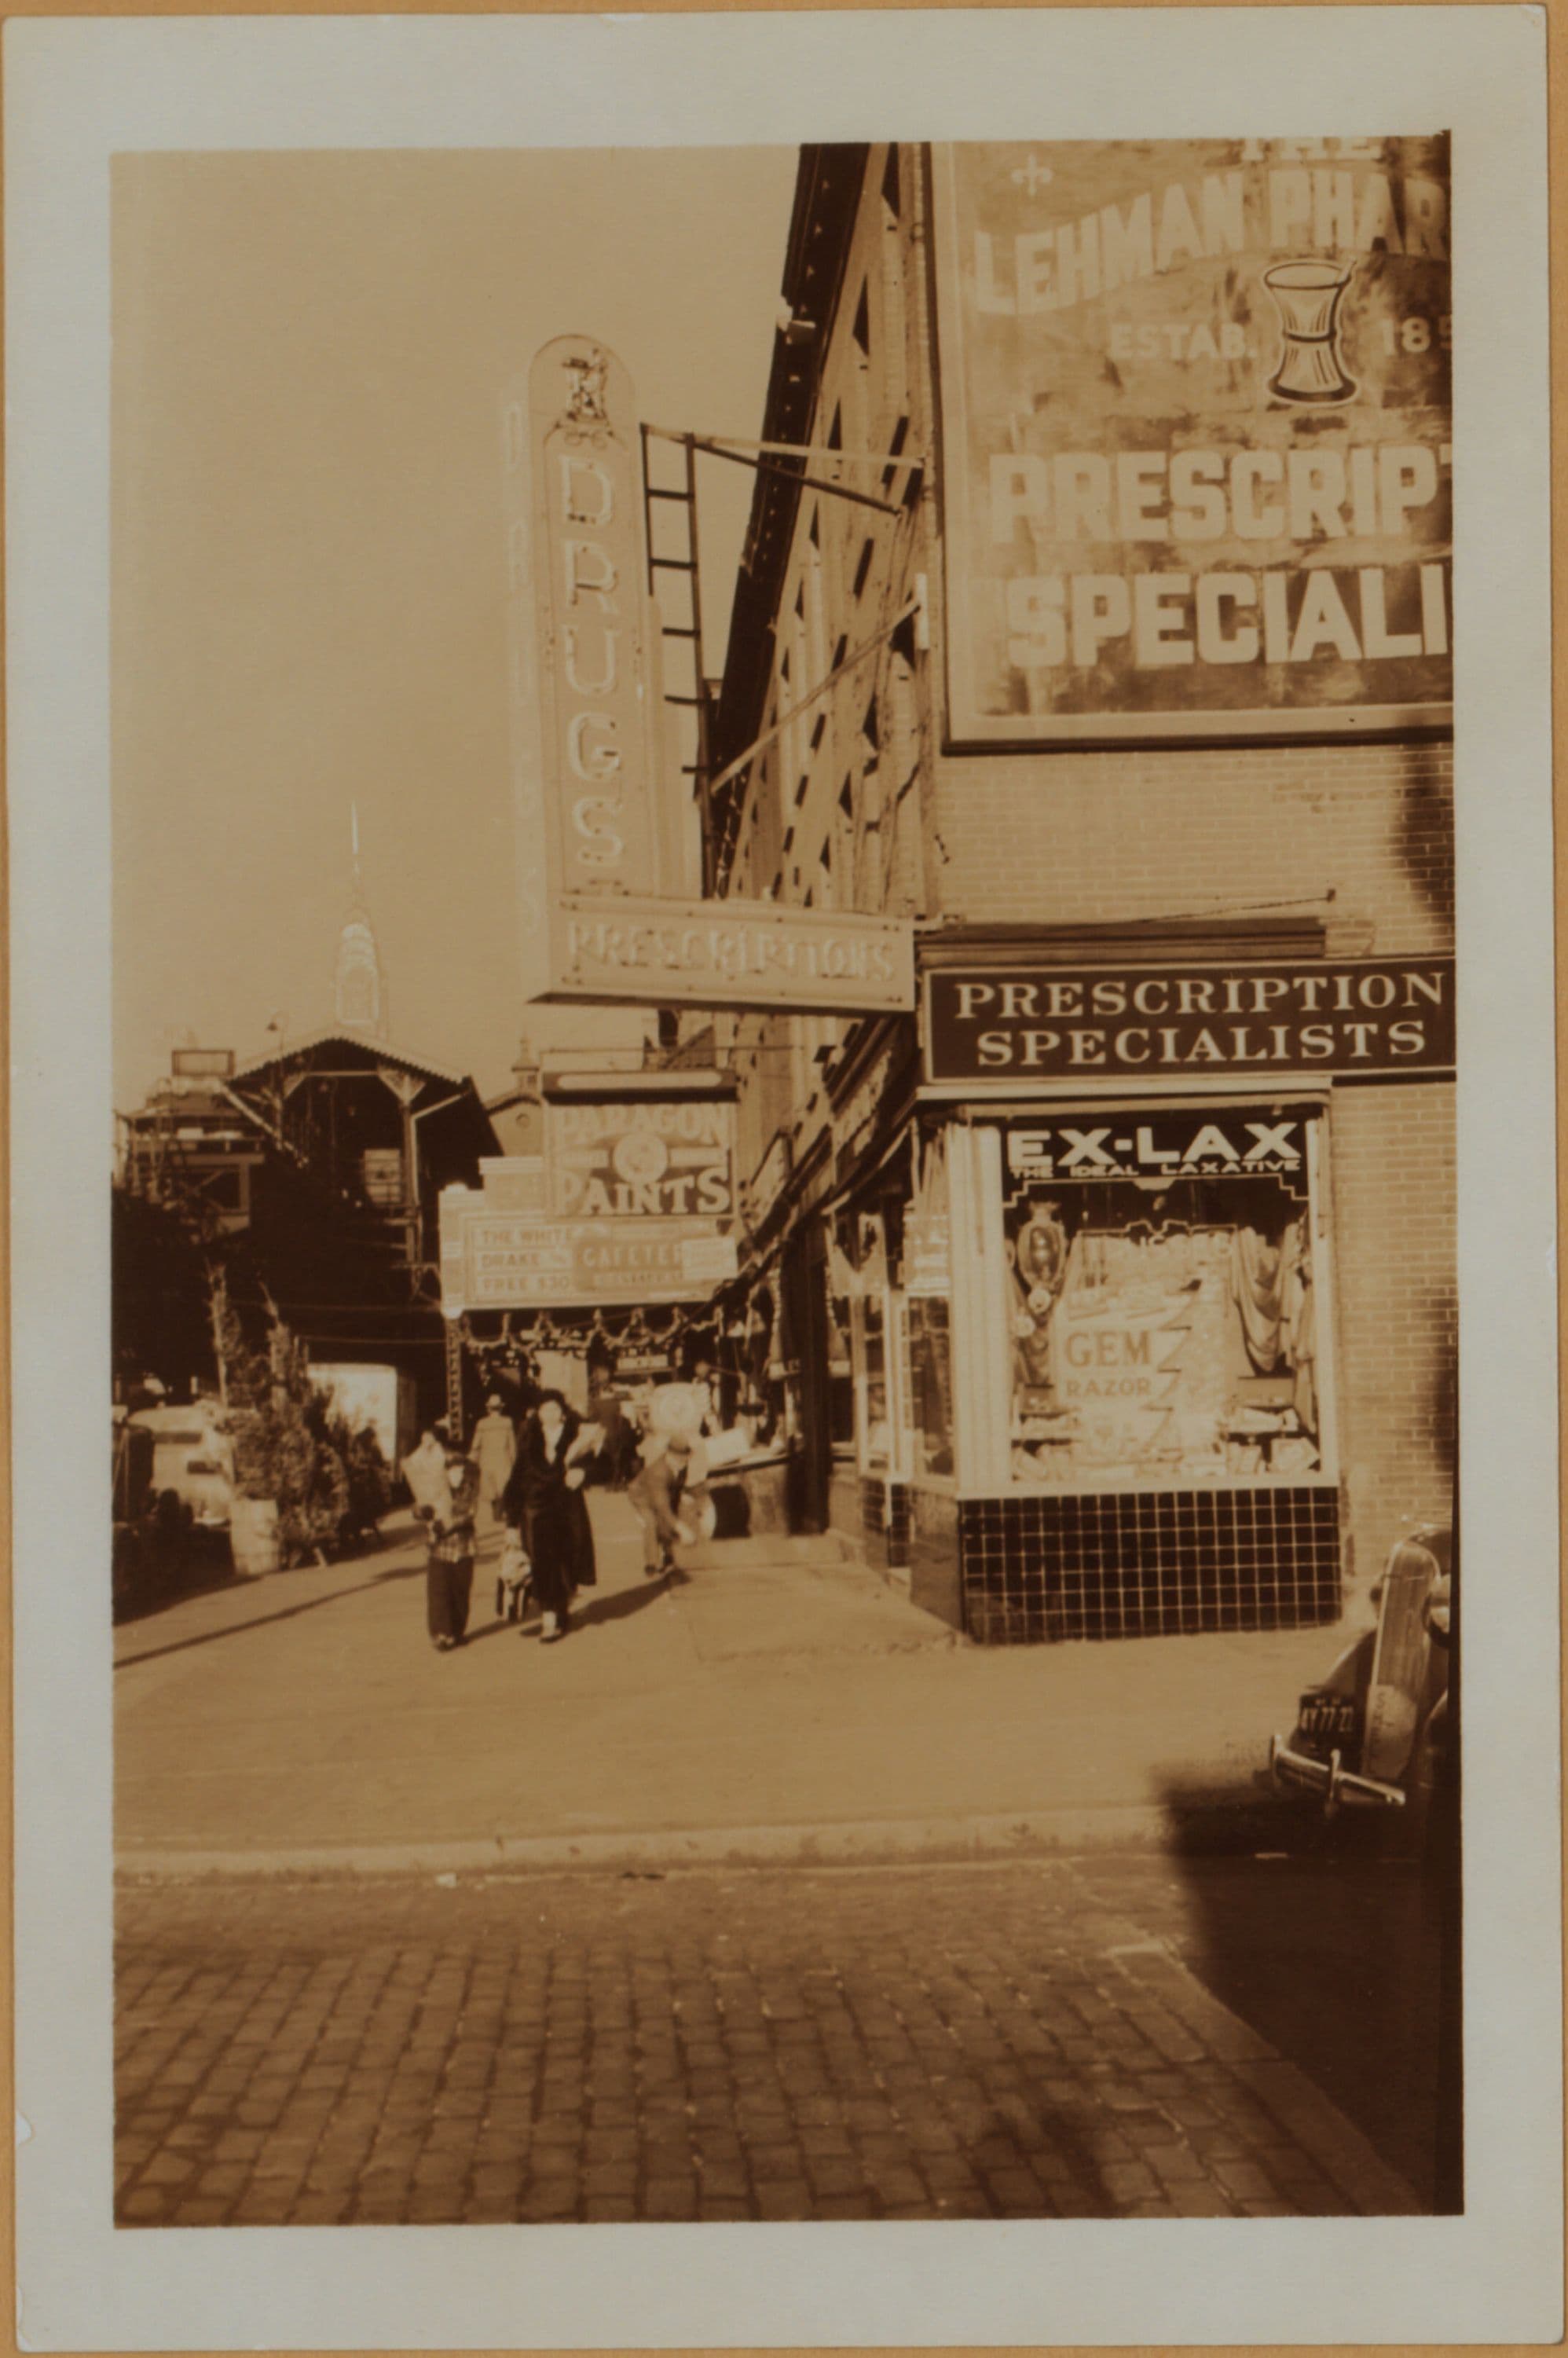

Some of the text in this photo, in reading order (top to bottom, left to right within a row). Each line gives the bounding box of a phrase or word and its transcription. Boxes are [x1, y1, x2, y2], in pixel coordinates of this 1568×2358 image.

[975, 171, 1244, 314] LEHMAN
[1111, 323, 1258, 360] ESTAB.
[1006, 564, 1447, 669] SPECIALI
[559, 455, 625, 869] DRUGS
[566, 922, 896, 981] PRESCRIPTIONS
[954, 972, 1445, 1020] PRESCRIPTION
[977, 1020, 1426, 1067] SPECIALISTS
[1007, 1122, 1302, 1167] EX-LAX
[553, 1167, 731, 1216] PAINTS
[1010, 1159, 1300, 1179] THE IDEAL LAXATIVE
[1066, 1330, 1152, 1367] GEM
[1066, 1378, 1152, 1397] RAZOR
